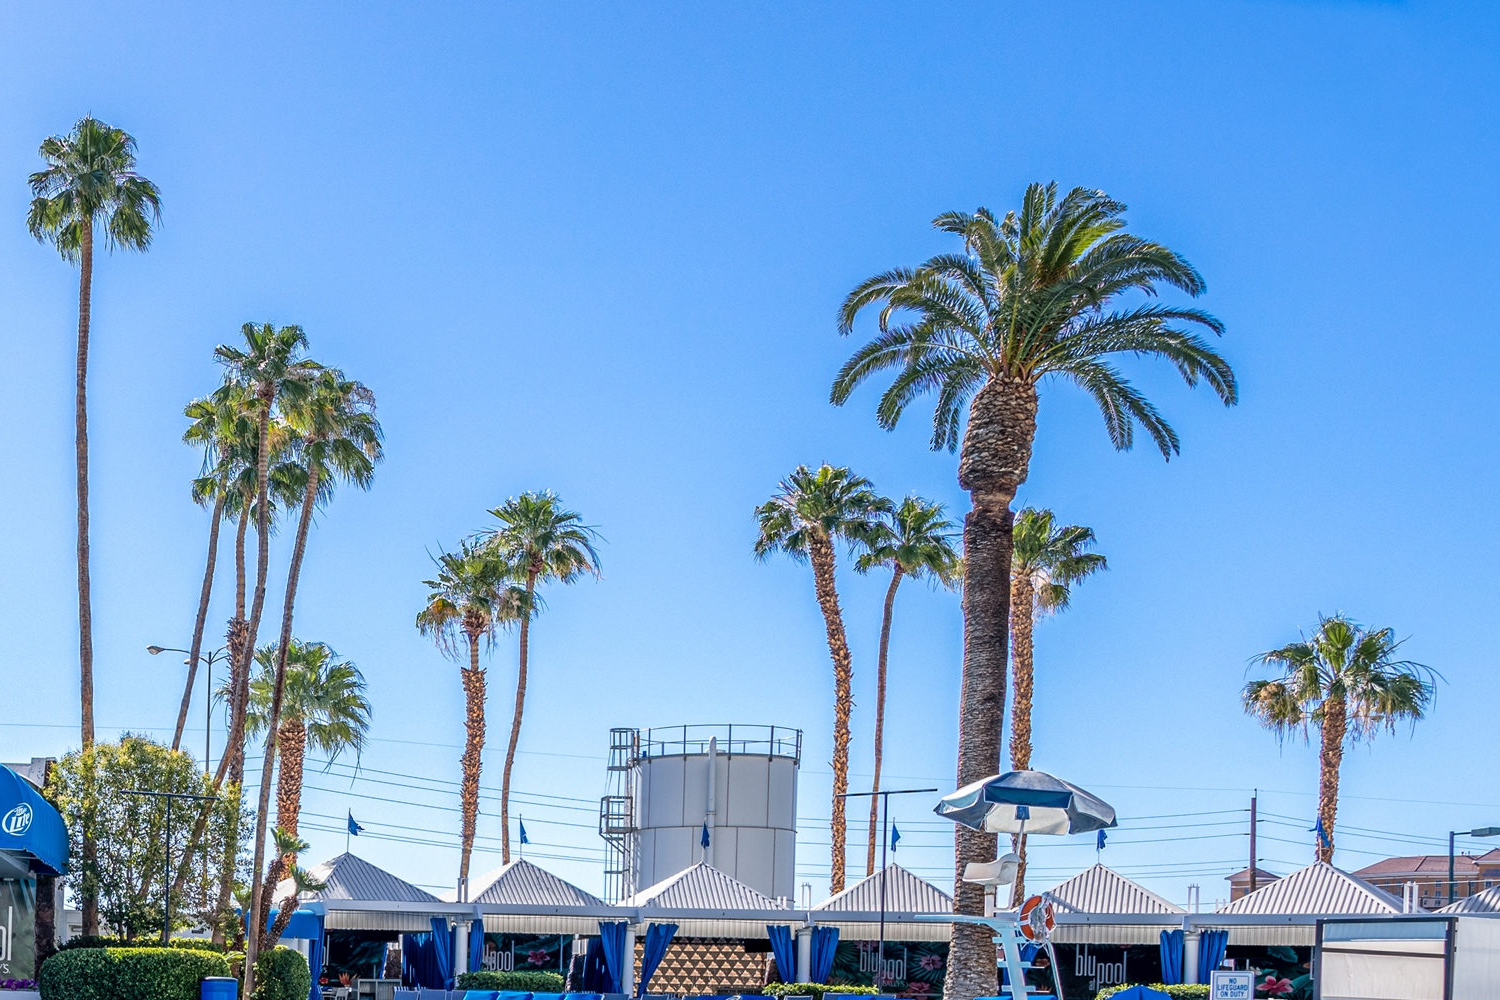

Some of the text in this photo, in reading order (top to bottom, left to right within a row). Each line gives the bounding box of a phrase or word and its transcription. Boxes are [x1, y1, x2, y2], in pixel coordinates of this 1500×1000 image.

[1075, 944, 1097, 977] blu
[1096, 950, 1128, 994] pool
[1228, 977, 1238, 985] NO
